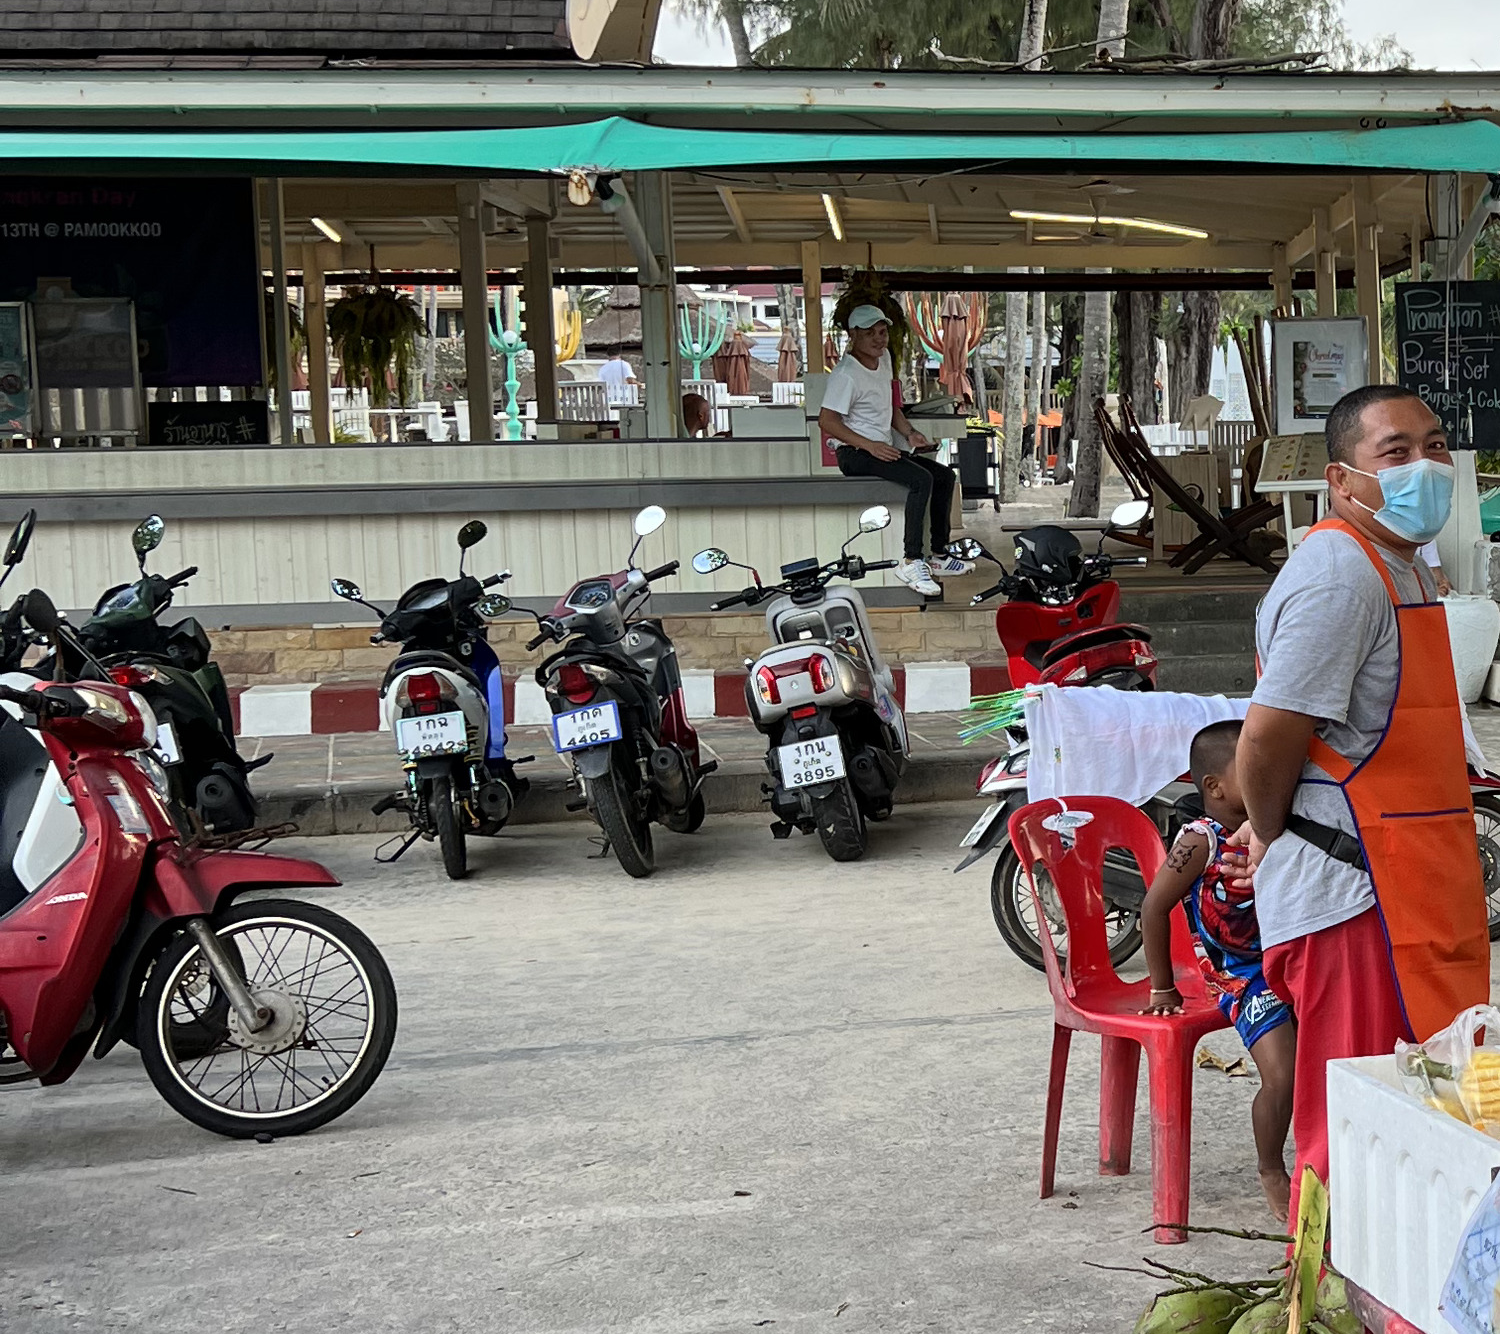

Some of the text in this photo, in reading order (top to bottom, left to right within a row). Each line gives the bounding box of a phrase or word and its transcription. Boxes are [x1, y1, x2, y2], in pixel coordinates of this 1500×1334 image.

[64, 222, 162, 237] PAMOOKKOO
[1403, 289, 1482, 331] Promotion
[1402, 340, 1489, 382] Burger Set
[567, 729, 610, 747] 4405
[793, 765, 835, 785] 3895
